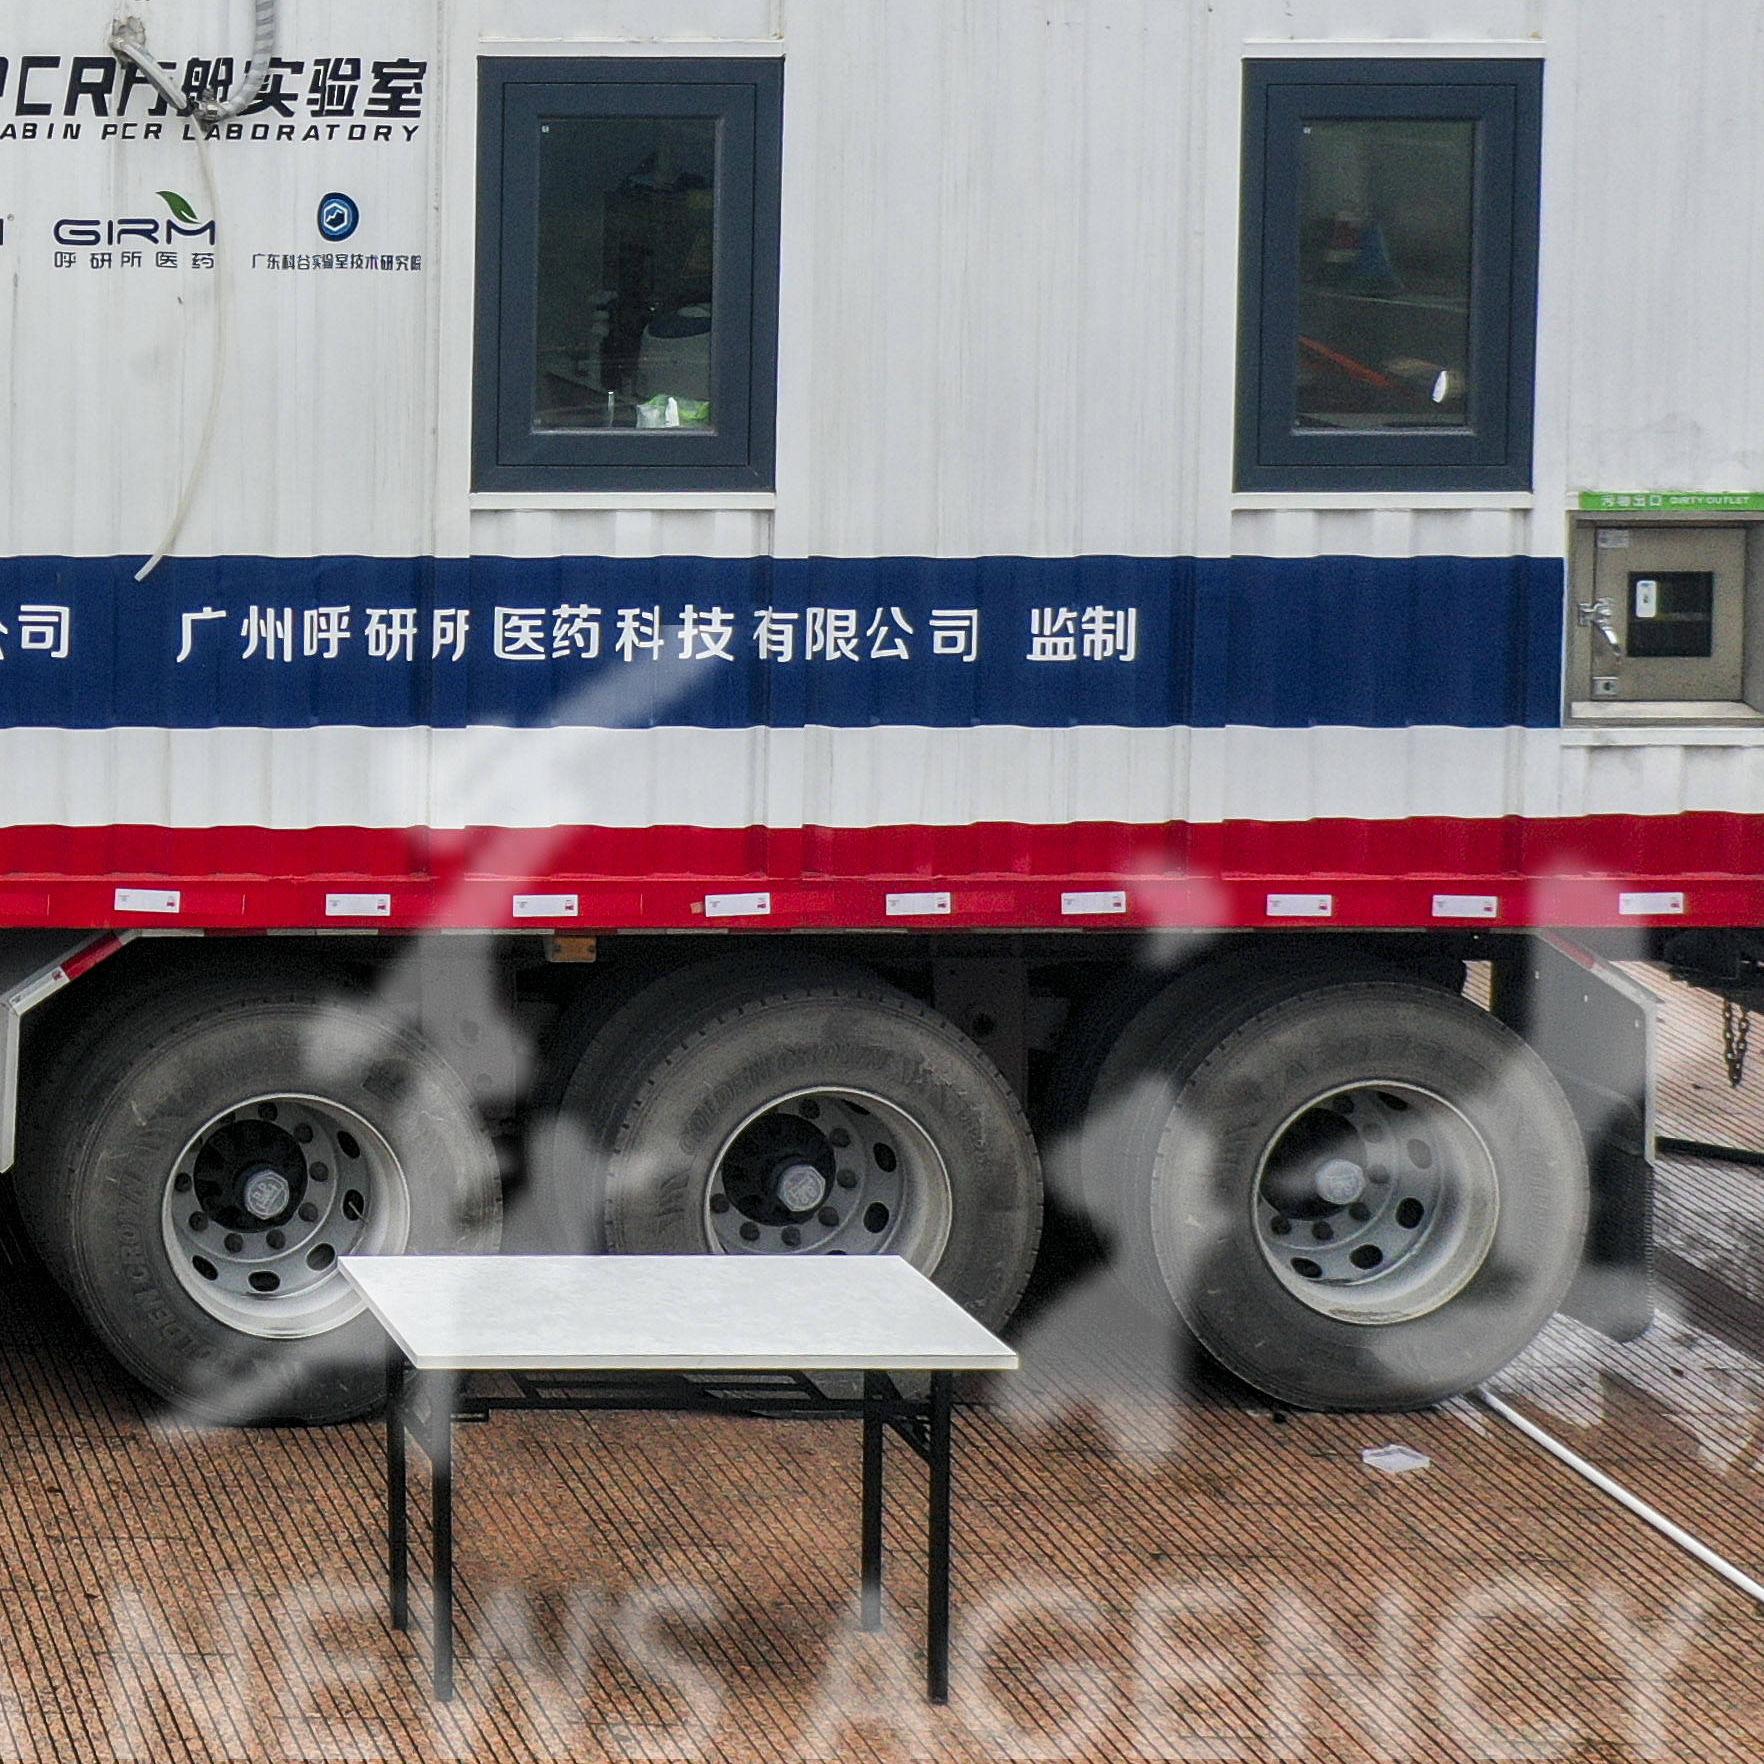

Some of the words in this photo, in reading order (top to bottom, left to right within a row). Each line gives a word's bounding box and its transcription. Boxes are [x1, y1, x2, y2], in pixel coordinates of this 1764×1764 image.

[101, 122, 163, 141] PCR
[183, 123, 420, 142] LABORATORY
[53, 218, 216, 246] GIRM
[54, 251, 215, 269] 呼研所医药
[176, 603, 979, 662] 广州呼研所医药科技有限公司
[1026, 604, 1138, 662] 监制
